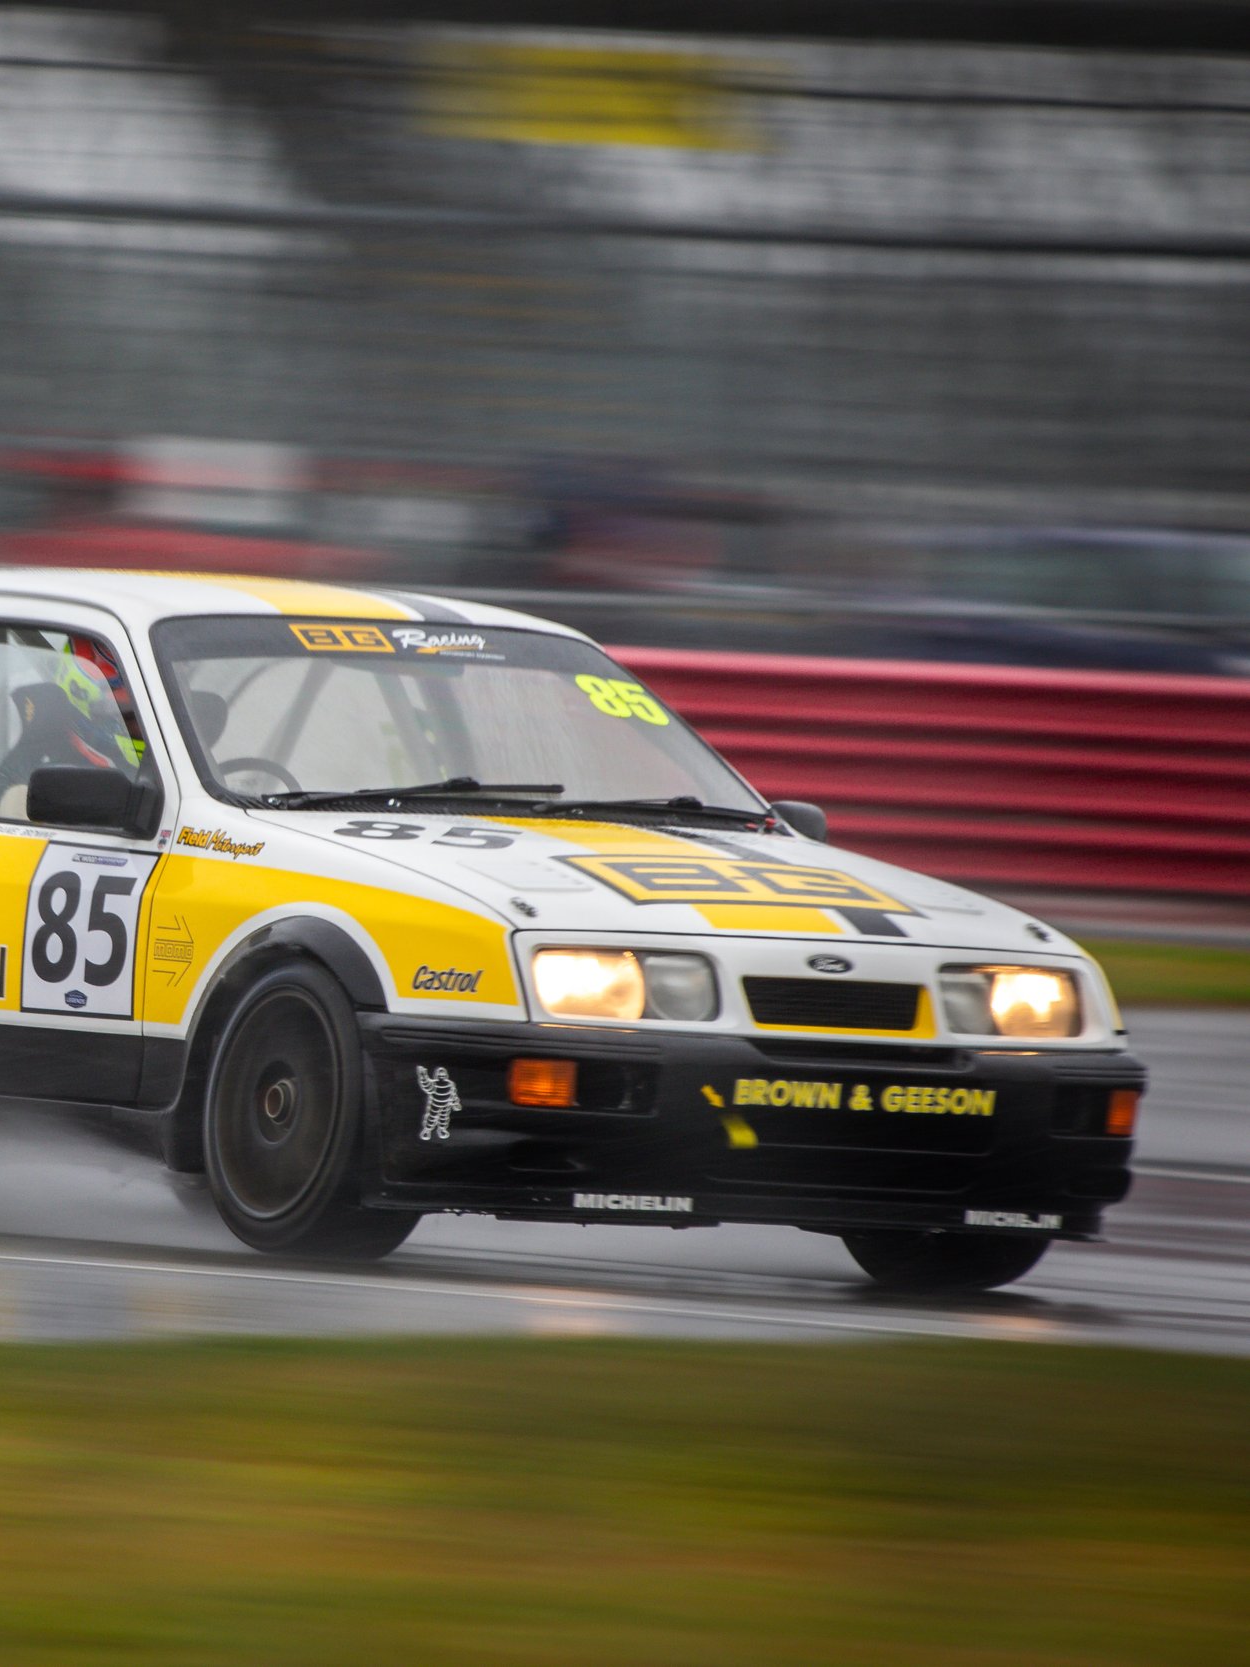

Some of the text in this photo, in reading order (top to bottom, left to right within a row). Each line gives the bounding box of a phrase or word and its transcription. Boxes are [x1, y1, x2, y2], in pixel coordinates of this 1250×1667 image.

[392, 628, 486, 650] Racing
[575, 673, 670, 727] 85
[176, 825, 211, 850] Field
[333, 819, 522, 850] 85
[31, 870, 137, 987] 85
[412, 965, 483, 993] Castrol
[733, 1079, 996, 1116] BROWN & GEESON
[573, 1193, 692, 1212] MICHELIN
